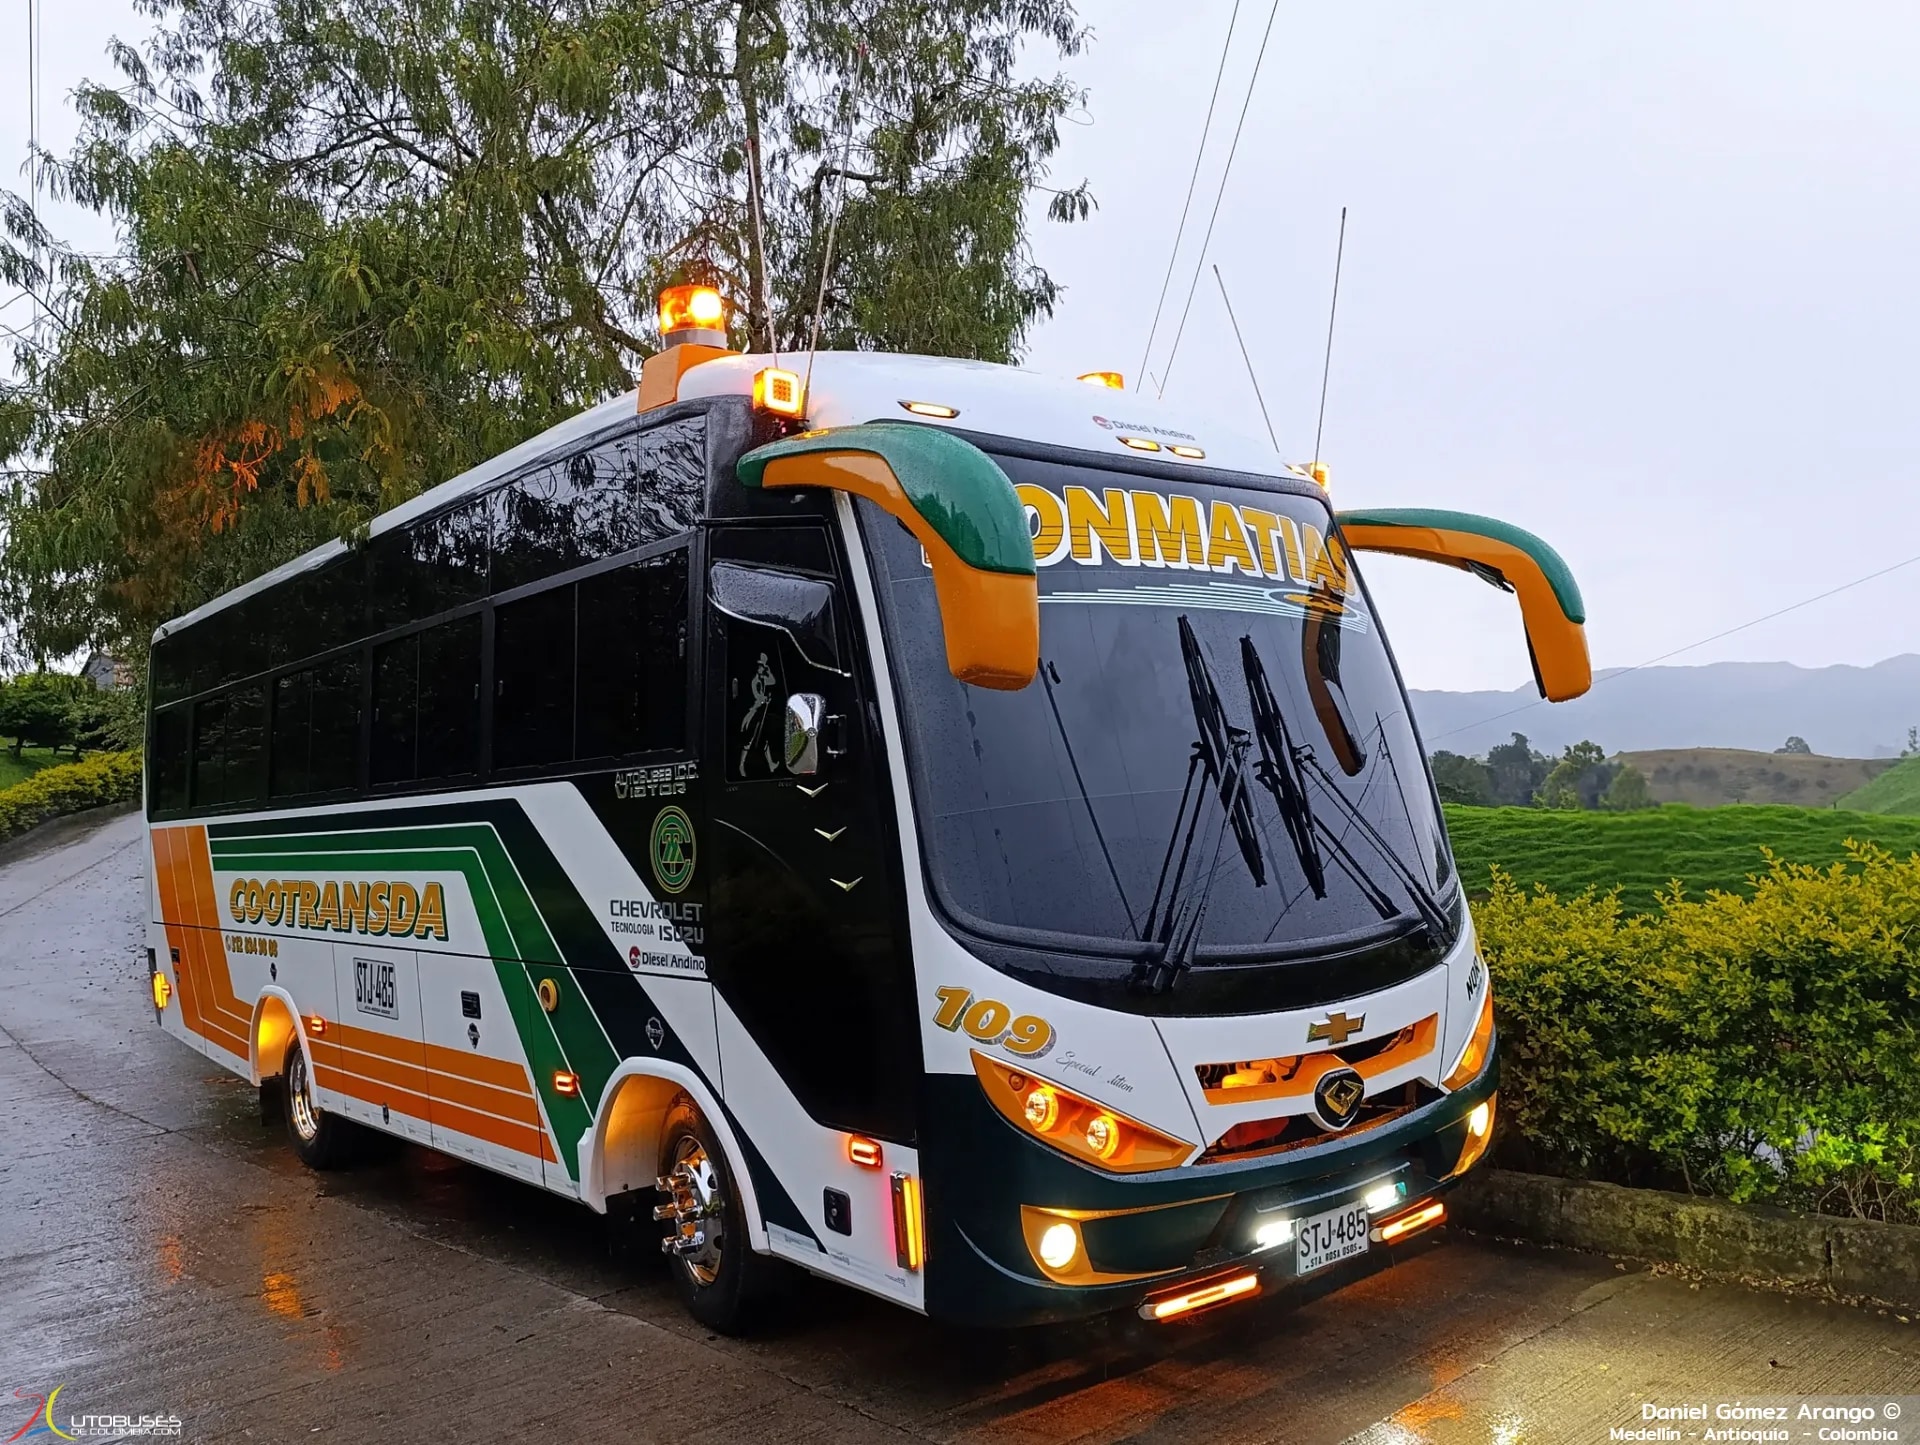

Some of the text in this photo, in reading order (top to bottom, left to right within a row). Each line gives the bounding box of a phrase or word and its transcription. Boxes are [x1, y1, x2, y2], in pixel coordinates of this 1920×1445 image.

[1111, 420, 1196, 441] Diesel Andino
[921, 483, 1357, 600] ONMATIAS
[229, 878, 449, 942] COOTRANSDA
[610, 899, 703, 922] CHEVROLET
[611, 921, 704, 945] TECNOLOGIA ISUZU
[642, 952, 705, 971] Diesel Andino
[932, 985, 1057, 1060] 109
[1055, 1051, 1103, 1077] Special
